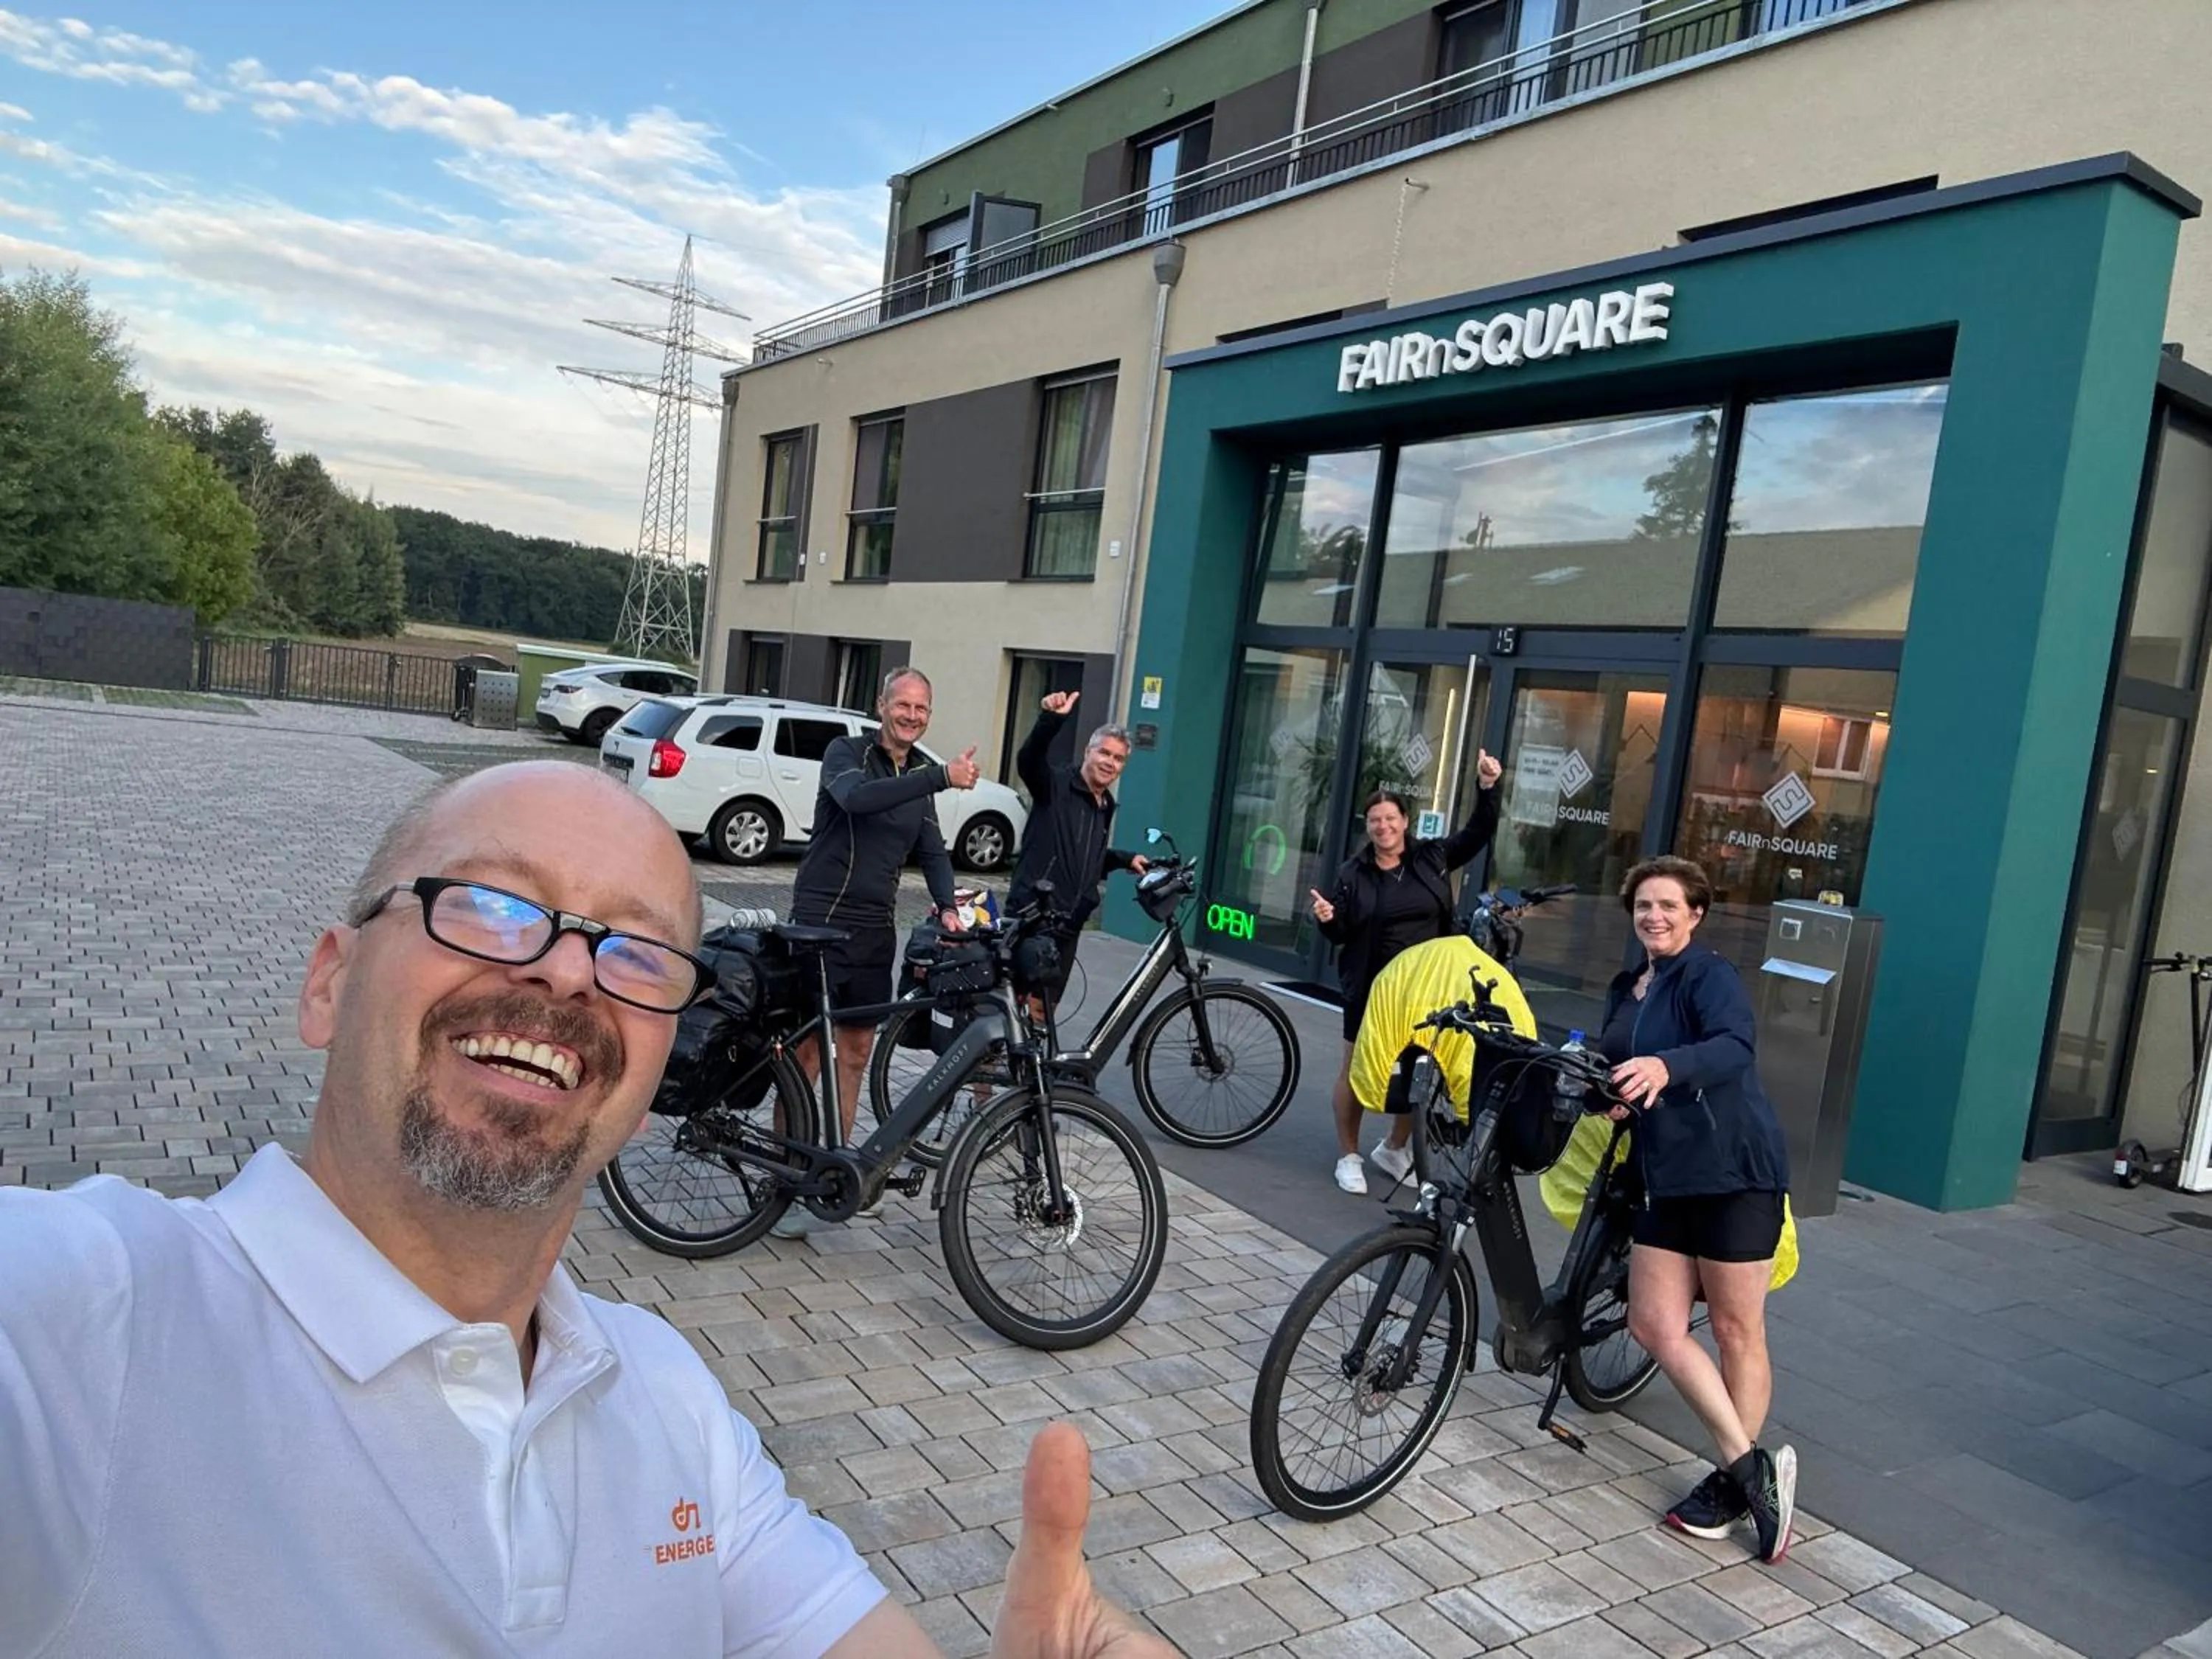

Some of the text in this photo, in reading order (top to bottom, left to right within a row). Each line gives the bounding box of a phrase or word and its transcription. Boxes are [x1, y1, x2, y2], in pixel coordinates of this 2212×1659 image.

[1338, 282, 1674, 392] FAIRnSQUARE
[1497, 627, 1514, 653] 15
[1728, 831, 1838, 860] FAIRnSQUARE
[1207, 904, 1254, 940] OPEN
